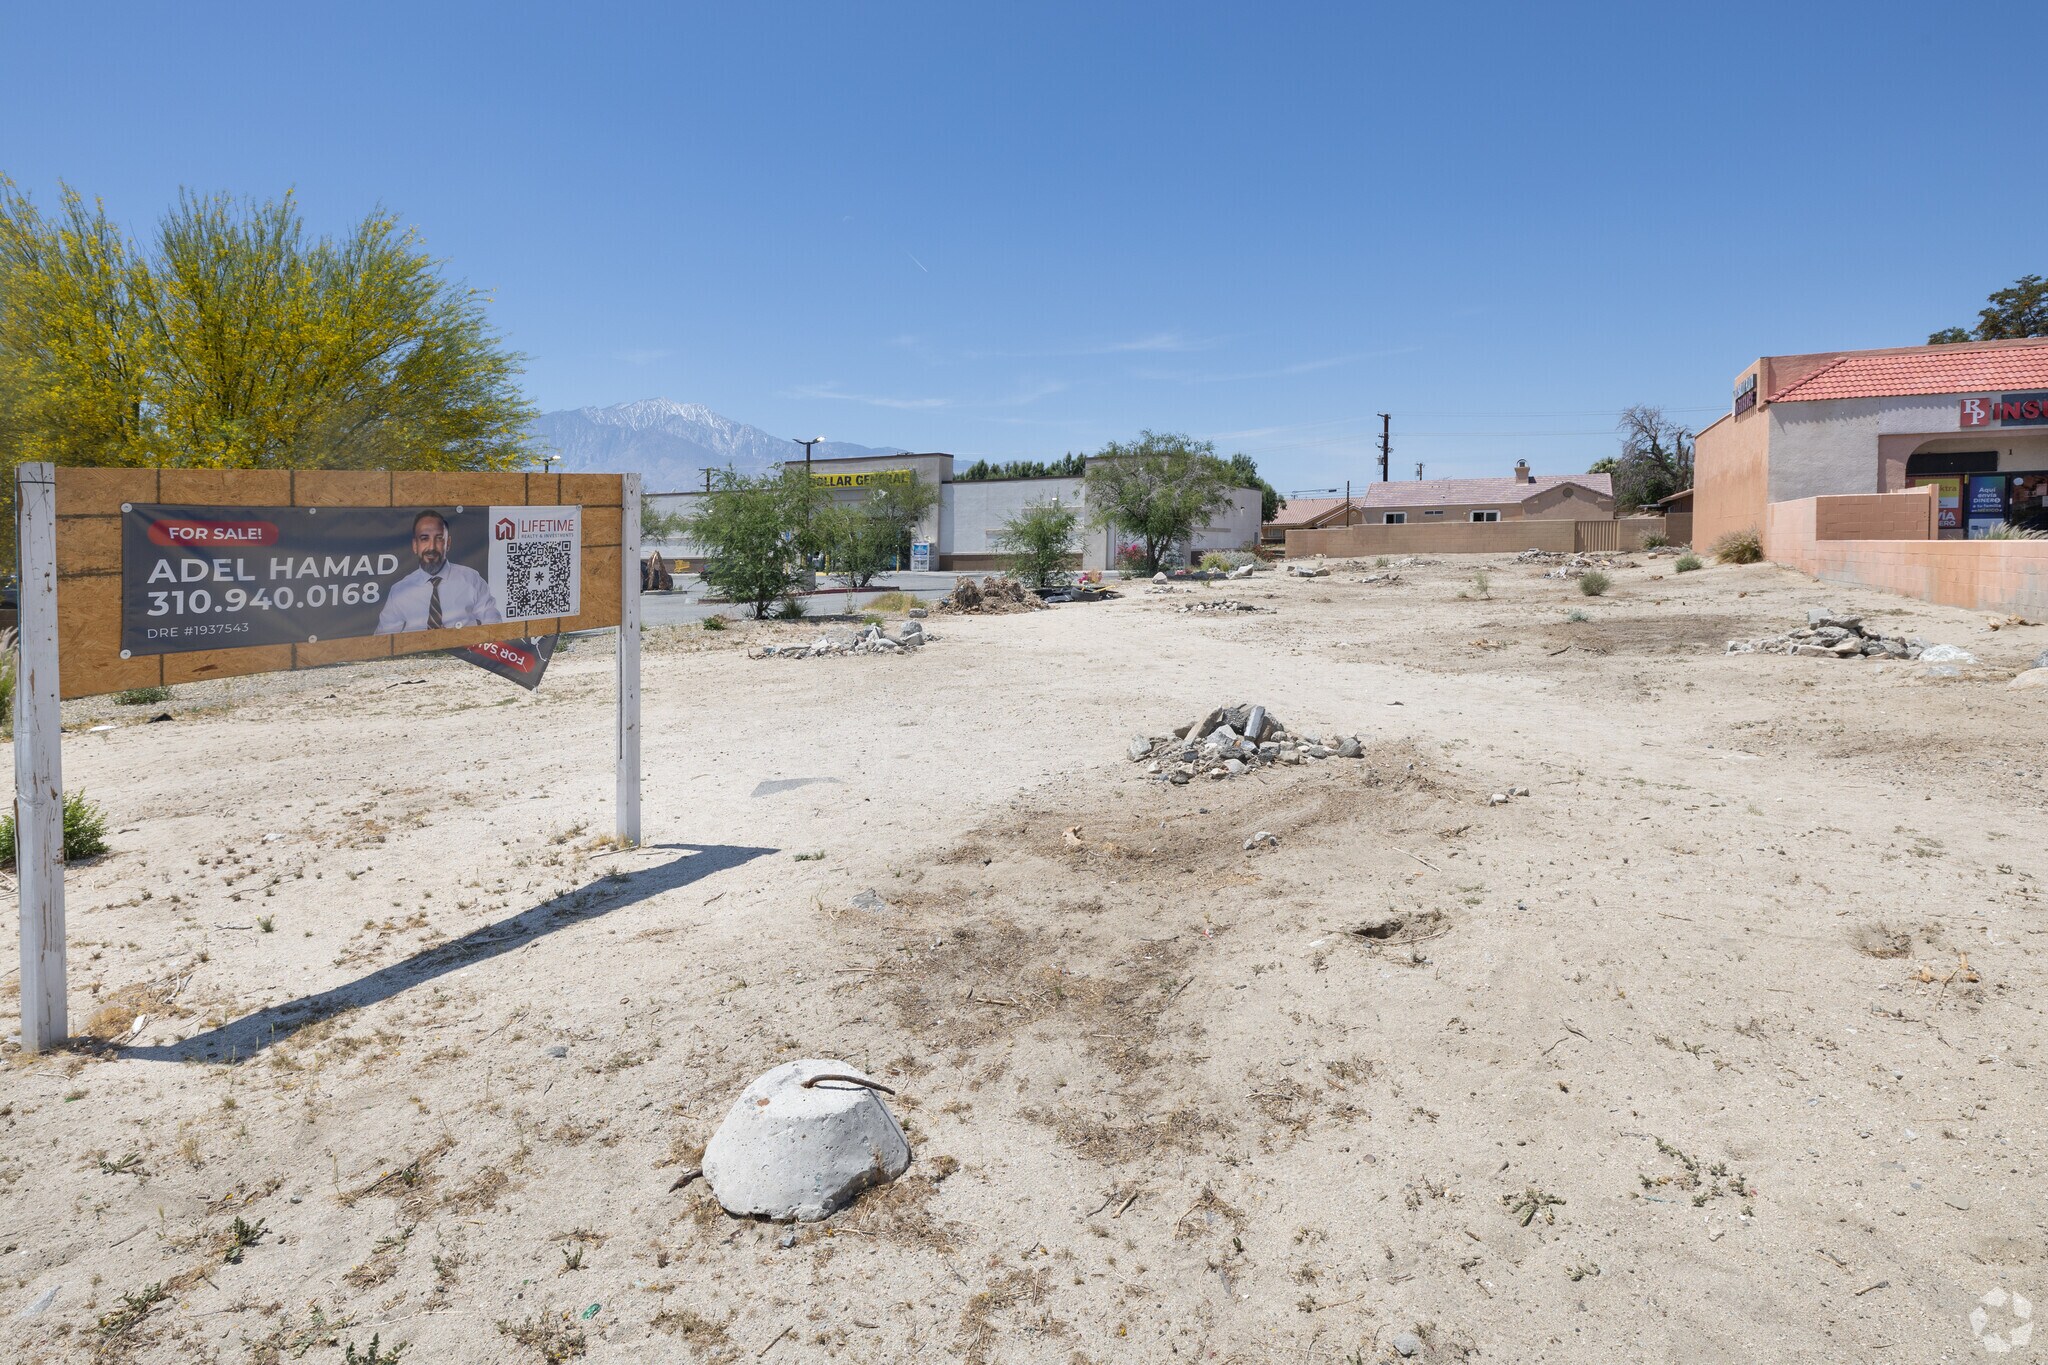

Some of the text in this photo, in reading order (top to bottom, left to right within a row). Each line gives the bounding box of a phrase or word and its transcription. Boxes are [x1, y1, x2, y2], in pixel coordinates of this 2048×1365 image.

[809, 476, 852, 487] OLLAR
[168, 527, 262, 540] FOR SALE!
[521, 519, 574, 532] LIFETIME
[146, 554, 399, 584] ADEL HAMAD
[146, 581, 380, 617] 310.940.0168
[147, 622, 249, 639] DRE #1937543
[472, 642, 525, 666] FOR SA
